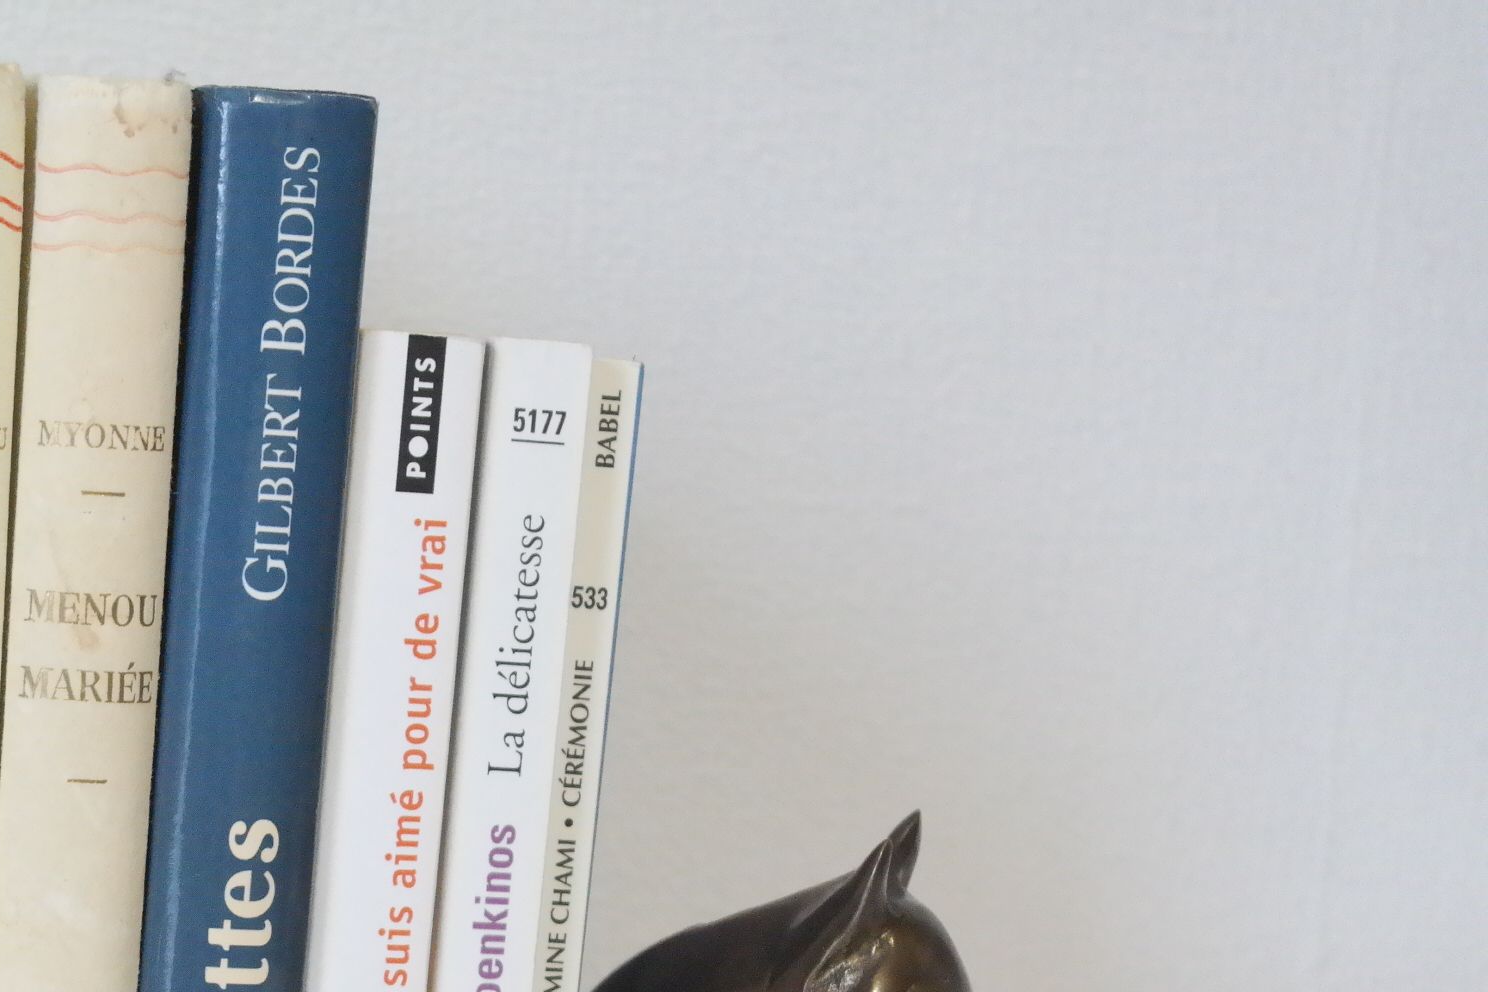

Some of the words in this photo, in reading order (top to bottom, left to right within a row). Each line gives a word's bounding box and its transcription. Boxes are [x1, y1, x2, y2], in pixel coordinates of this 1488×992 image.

[37, 420, 165, 452] MYONNE
[406, 357, 436, 478] POINTS
[513, 408, 567, 436] 5177
[595, 389, 623, 468] BABEL
[414, 518, 447, 595] vrai
[24, 588, 157, 626] MENOU
[404, 613, 440, 660] de
[492, 514, 545, 715] délicatesse
[571, 586, 608, 610] 533
[18, 662, 153, 703] MARIÉE
[402, 676, 434, 771] pour
[487, 728, 526, 777] La
[558, 659, 594, 807] CÉRÉMONIE
[385, 790, 423, 888] aimé
[550, 839, 576, 924] CHAMI
[378, 906, 413, 986] suis
